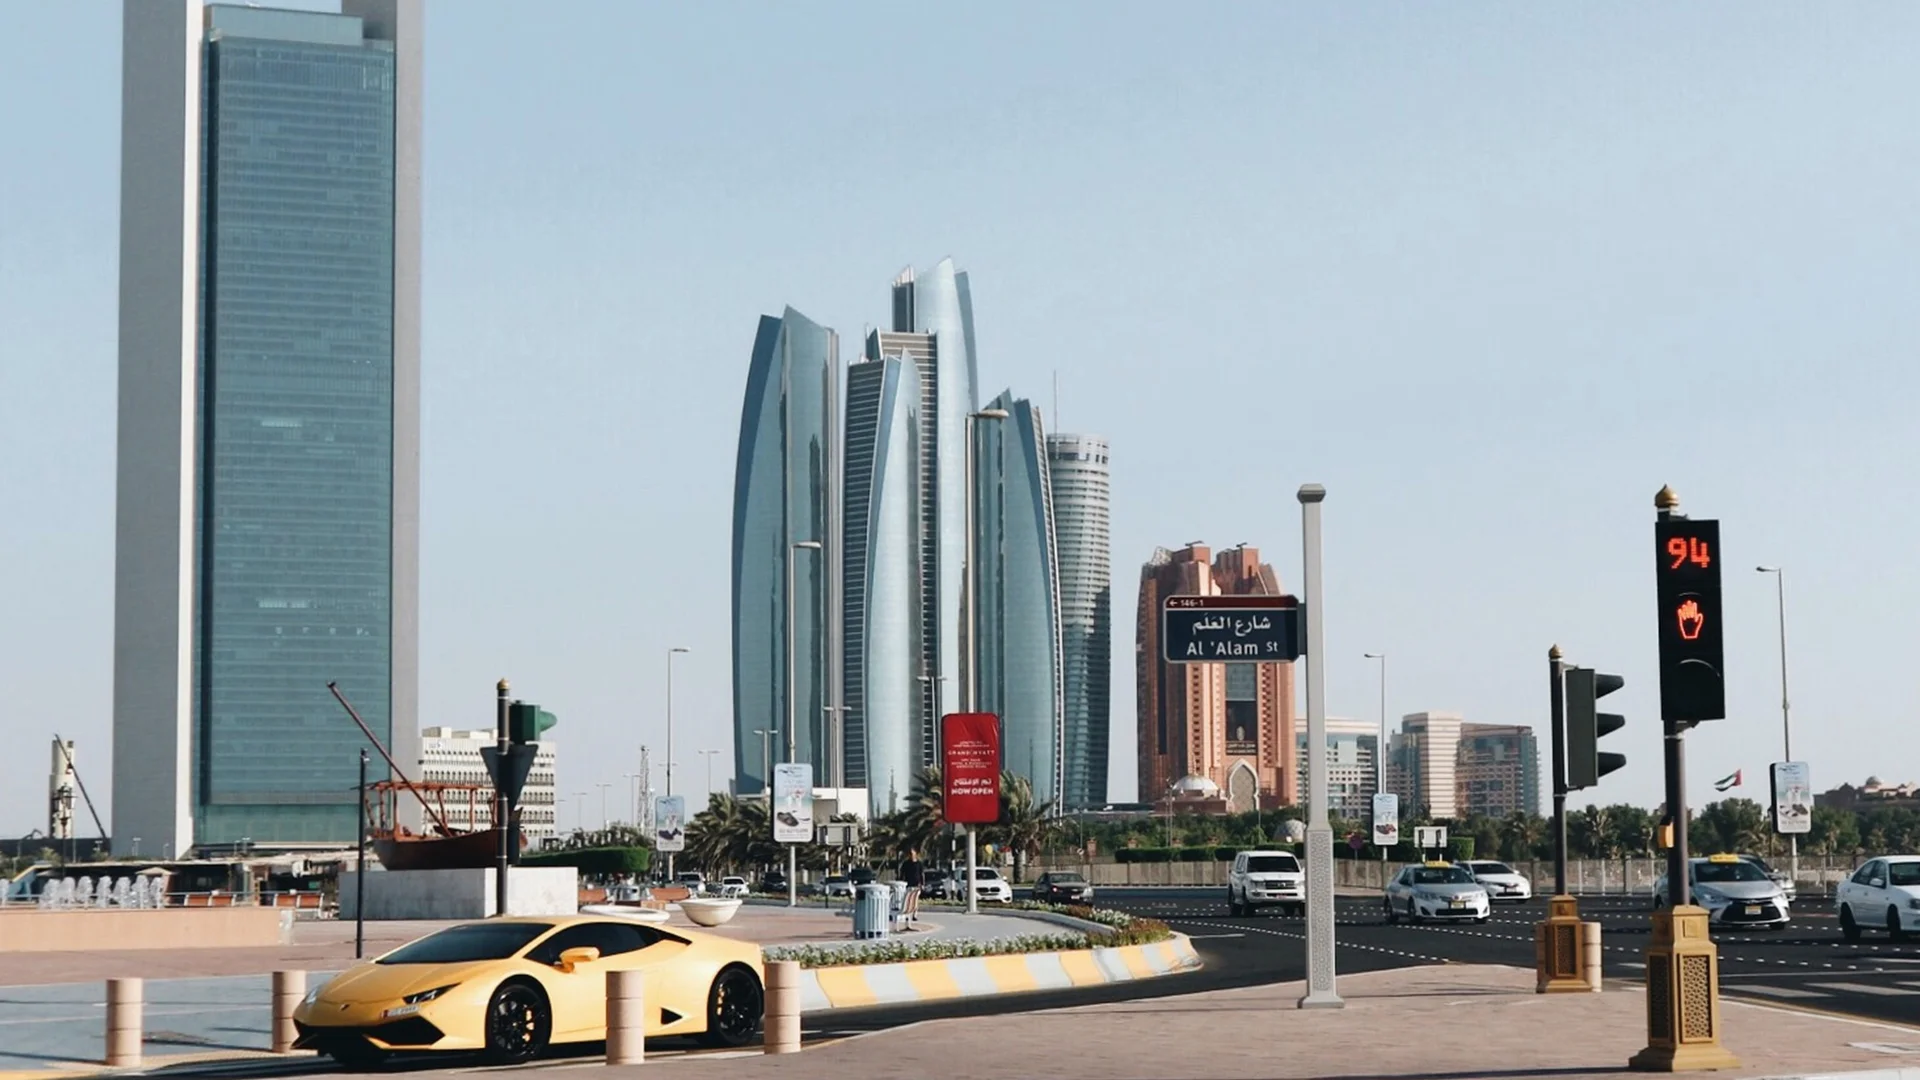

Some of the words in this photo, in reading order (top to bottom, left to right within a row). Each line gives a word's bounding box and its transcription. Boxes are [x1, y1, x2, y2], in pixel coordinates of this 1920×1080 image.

[1668, 537, 1710, 569] 94
[1235, 614, 1271, 636] شارع
[1187, 641, 1204, 655] Al
[1266, 642, 1278, 652] St
